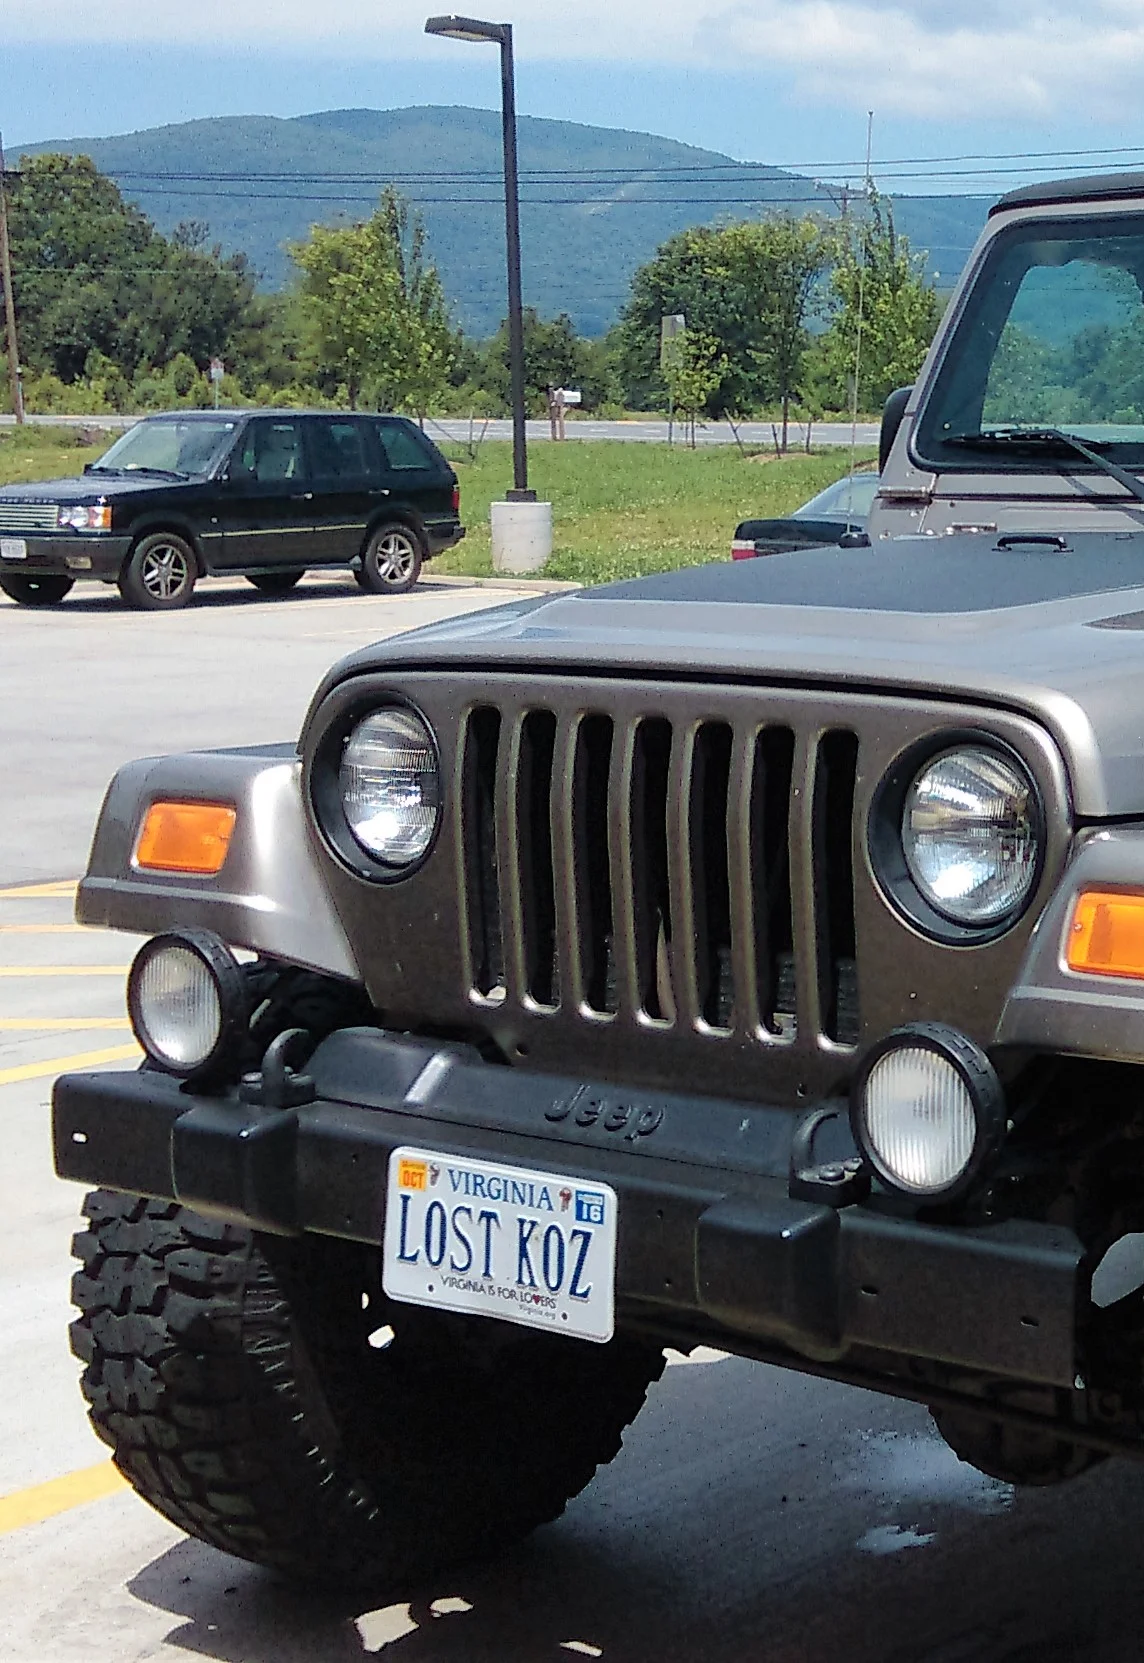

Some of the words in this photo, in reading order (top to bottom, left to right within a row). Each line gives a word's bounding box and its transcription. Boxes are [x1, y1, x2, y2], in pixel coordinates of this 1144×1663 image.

[544, 1083, 666, 1143] Jeep
[403, 1170, 424, 1189] OCT
[447, 1168, 555, 1212] VIRGINIA
[582, 1203, 602, 1222] 16
[397, 1193, 503, 1281] LOST
[516, 1216, 594, 1300] KOZ
[441, 1275, 485, 1294] VIRGINIA
[487, 1284, 495, 1296] IS
[498, 1286, 518, 1301] FOR
